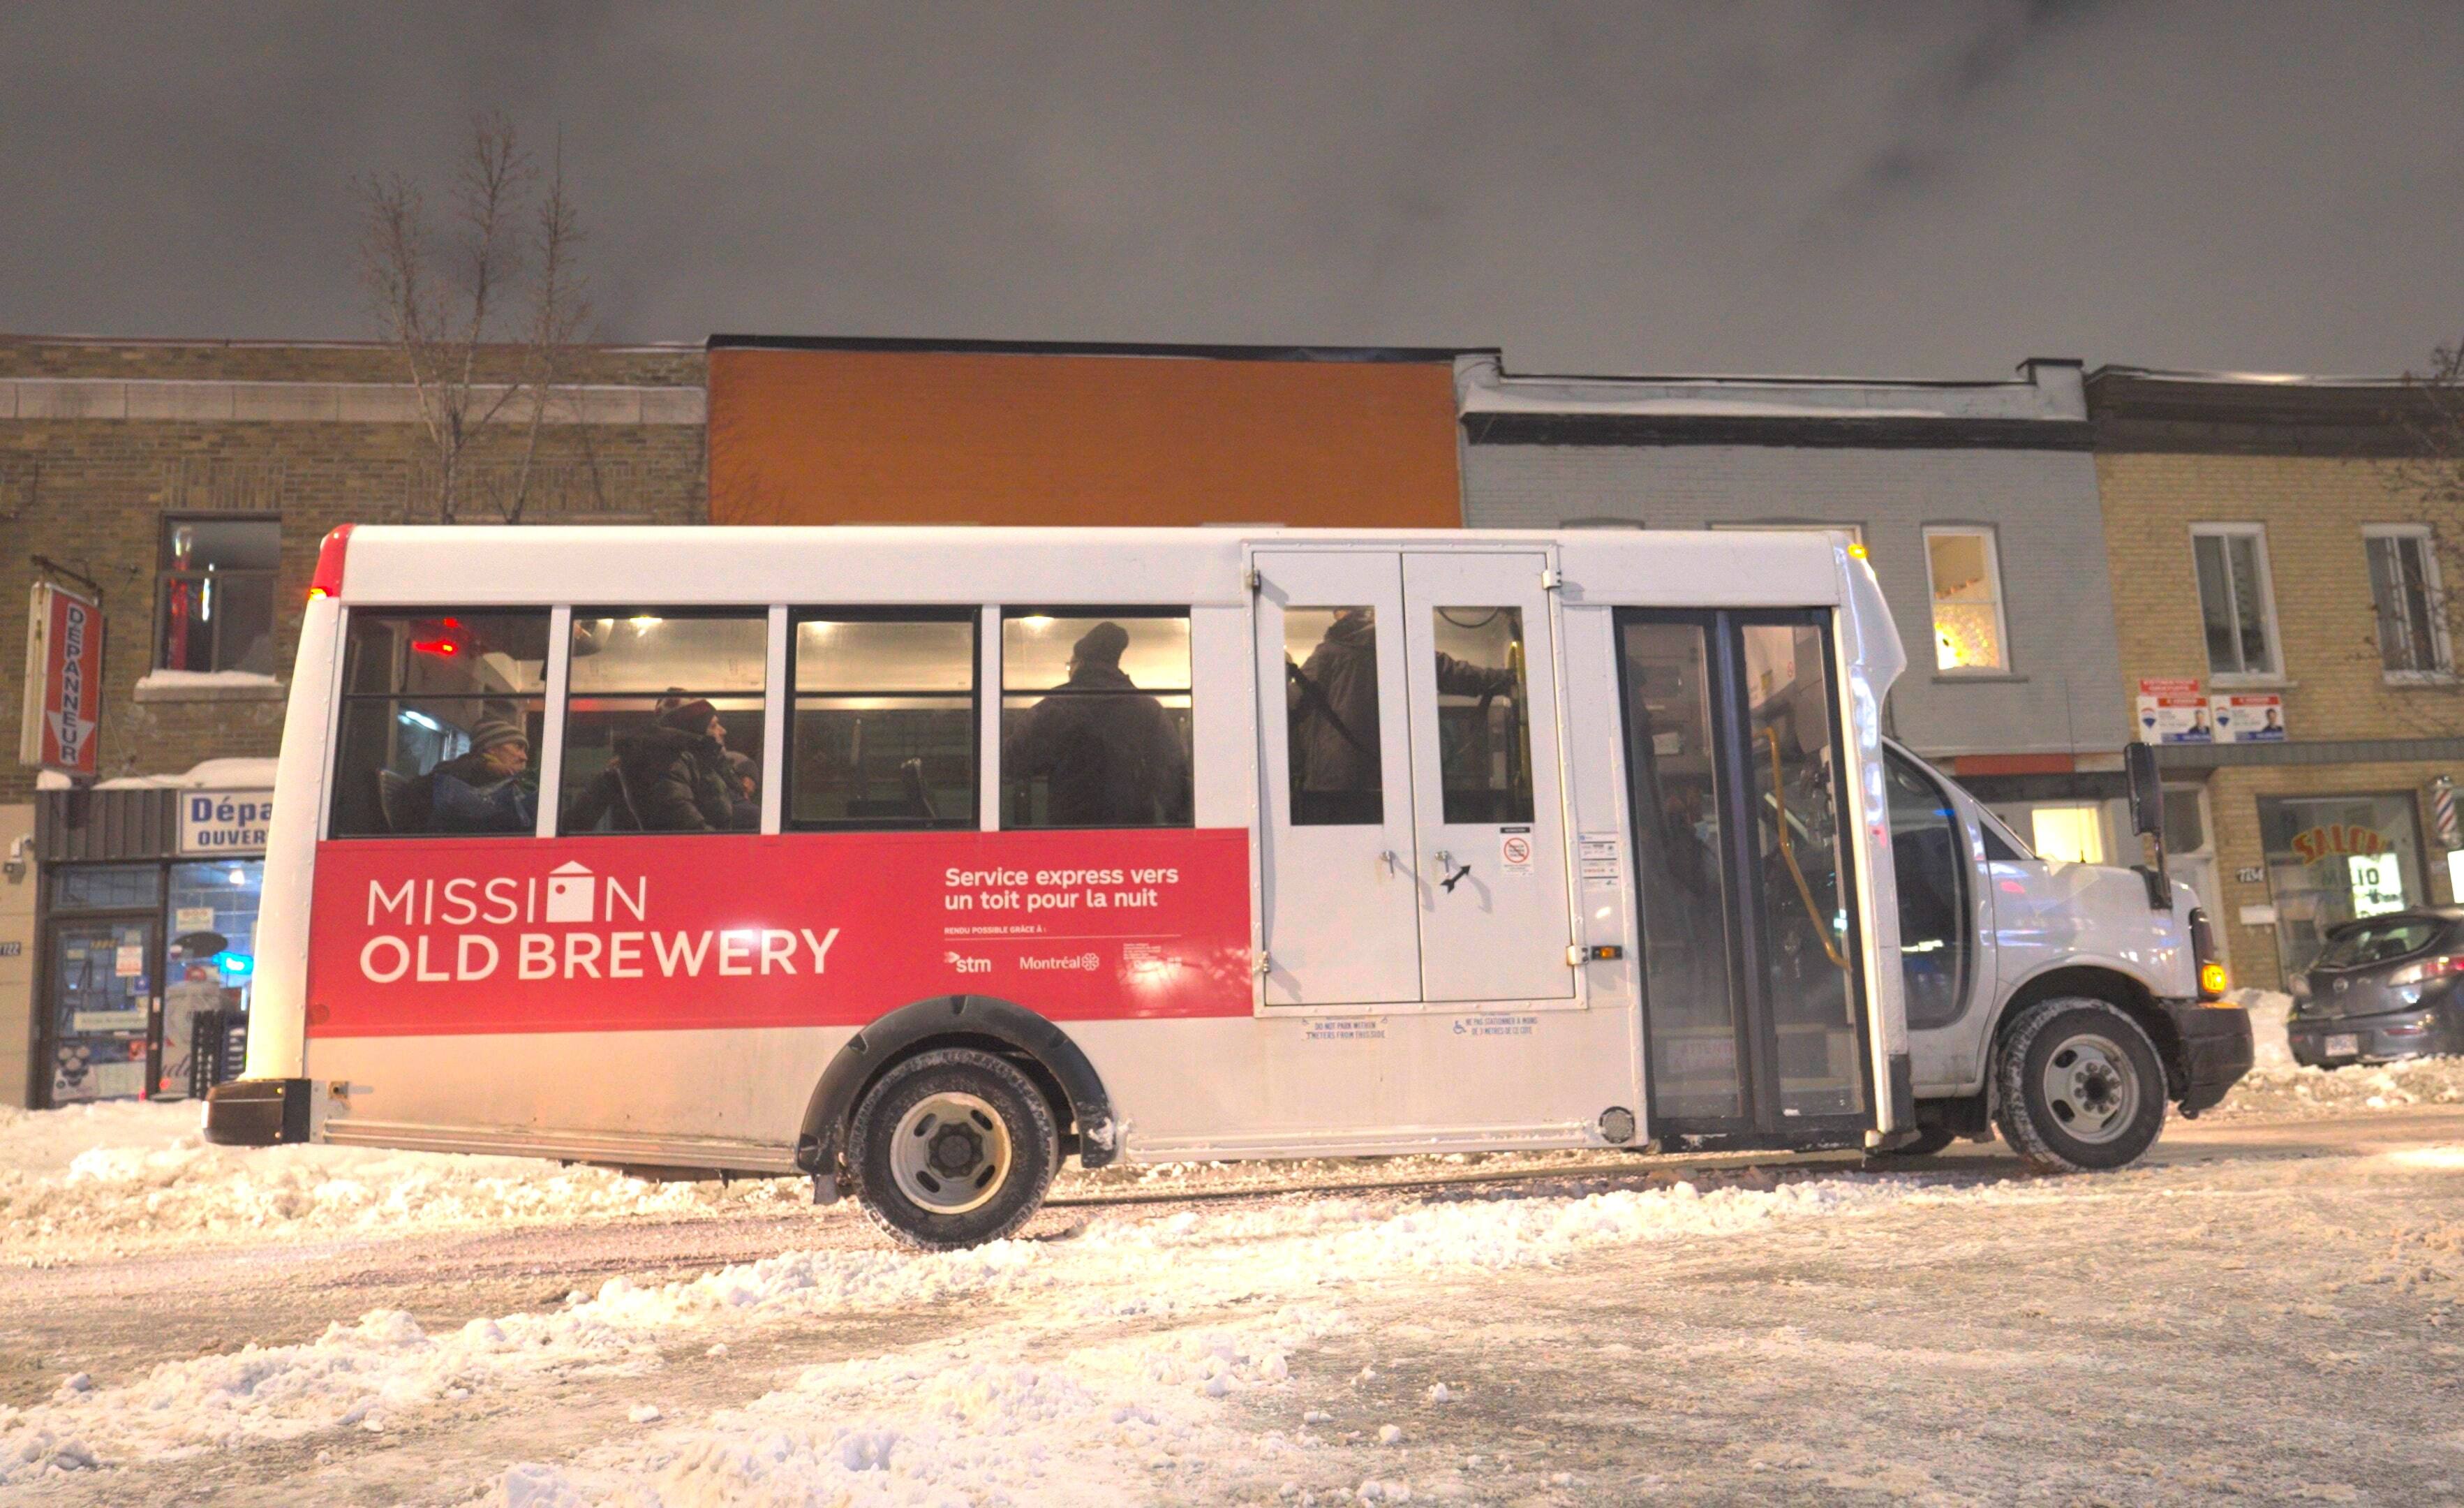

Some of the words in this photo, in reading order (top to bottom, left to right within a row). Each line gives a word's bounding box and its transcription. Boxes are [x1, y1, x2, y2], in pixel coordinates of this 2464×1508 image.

[61, 606, 84, 764] DEPANNEUR
[191, 796, 272, 827] Dépa
[198, 831, 269, 845] OUVER
[945, 867, 1028, 887] Service
[1036, 869, 1124, 889] express
[1130, 868, 1179, 883] vers
[944, 894, 972, 910] un
[980, 890, 1020, 909] toit
[1027, 893, 1079, 912] pour
[1086, 889, 1107, 908] la
[1114, 888, 1158, 908] nuit
[972, 926, 1008, 934] POSSIBLE
[1009, 924, 1034, 933] GRÂCE
[360, 934, 499, 984] OLD
[518, 928, 840, 980] BREWERY
[956, 956, 991, 973] stm
[1020, 955, 1081, 970] Montréal
